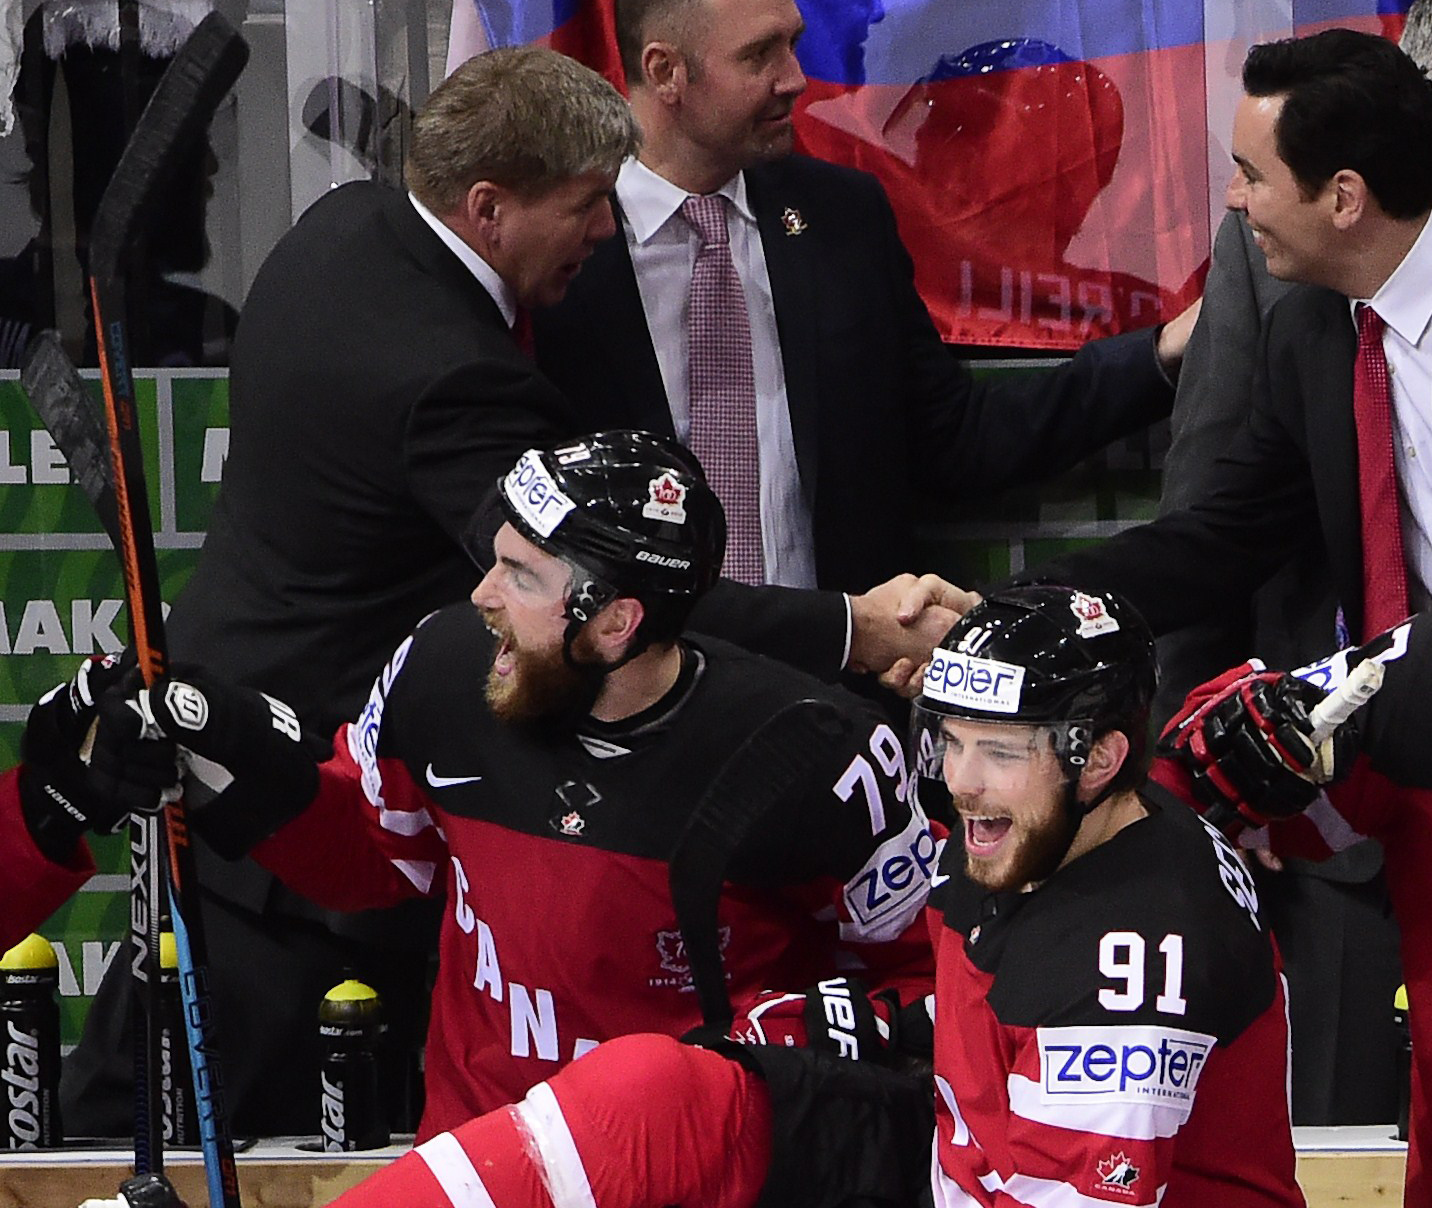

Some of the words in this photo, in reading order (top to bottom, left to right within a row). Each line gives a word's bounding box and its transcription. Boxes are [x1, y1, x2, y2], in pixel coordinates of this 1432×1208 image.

[924, 657, 1015, 698] epter
[832, 724, 908, 838] 79
[1097, 930, 1187, 1016] 91
[1044, 1038, 1205, 1093] zepter
